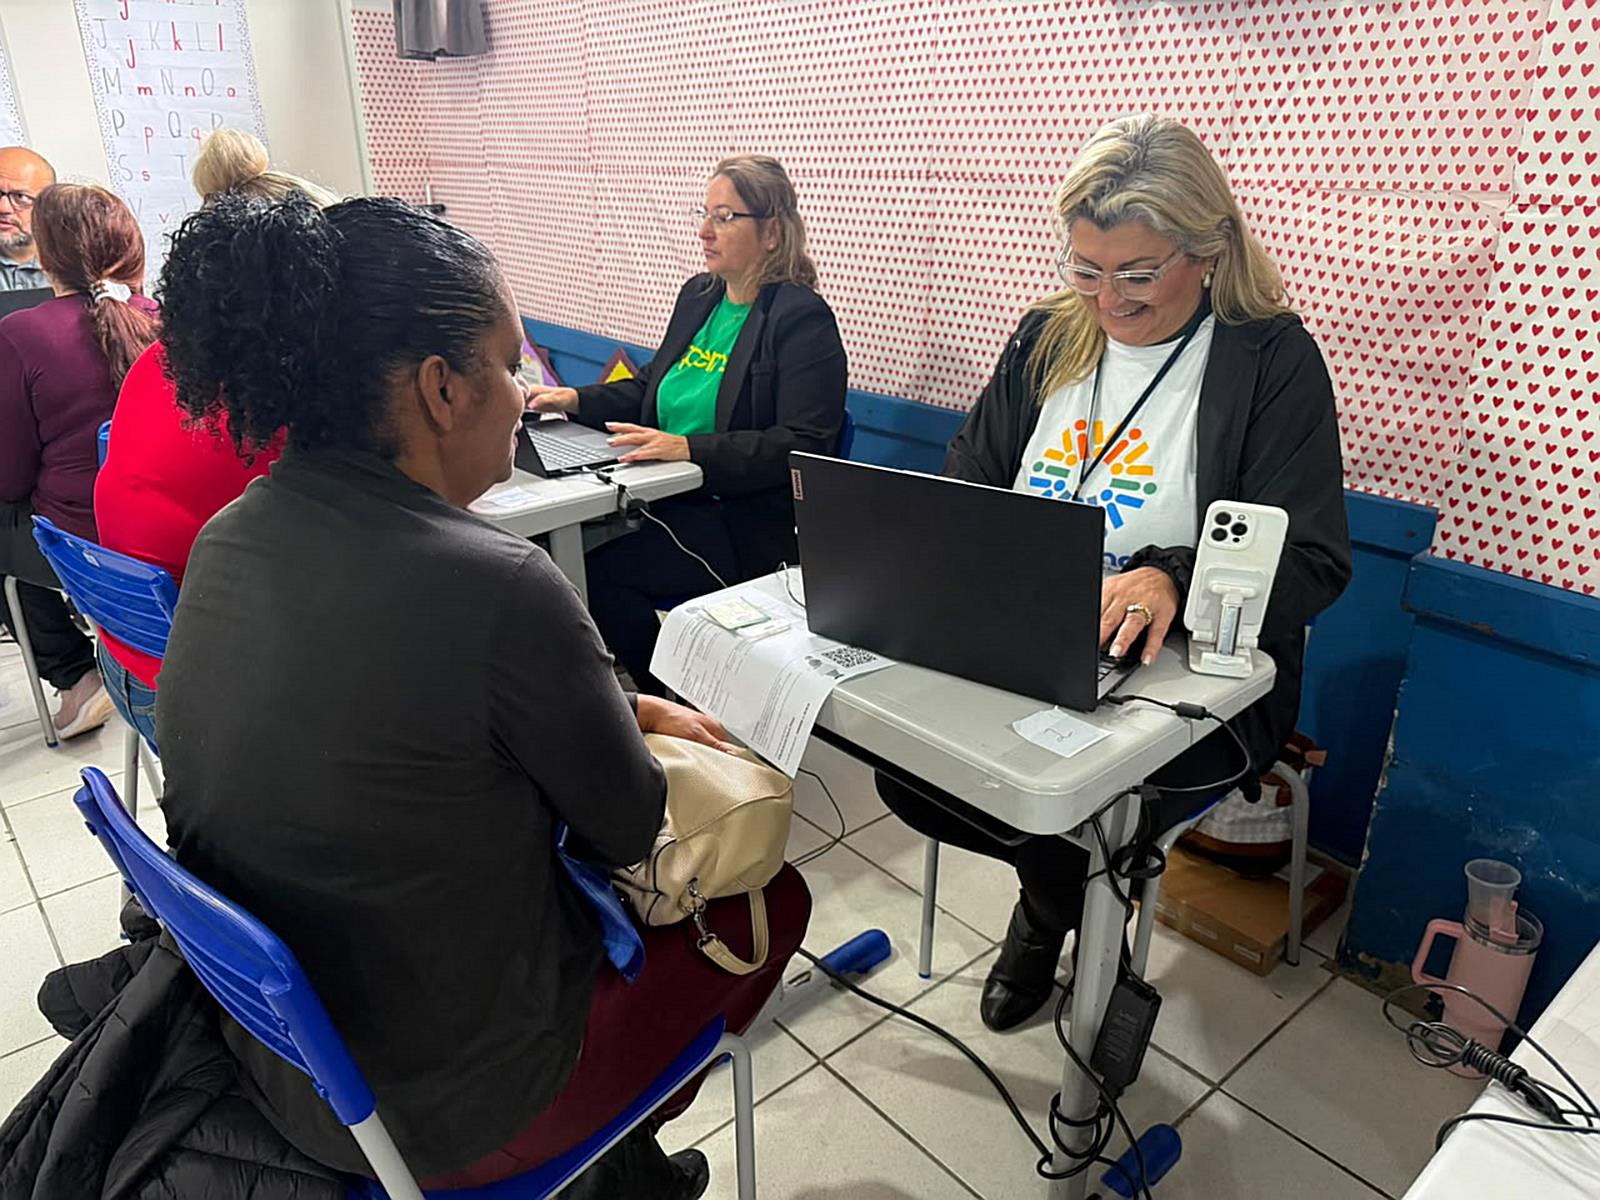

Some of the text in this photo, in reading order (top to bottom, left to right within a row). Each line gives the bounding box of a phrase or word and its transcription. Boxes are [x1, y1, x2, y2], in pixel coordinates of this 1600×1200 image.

[149, 21, 161, 50] K
[170, 21, 182, 51] k
[195, 22, 211, 52] L
[102, 67, 122, 95] M
[138, 86, 153, 96] m
[160, 68, 175, 95] N
[185, 86, 196, 97] n
[112, 109, 125, 137] P
[144, 126, 154, 155] p
[168, 111, 181, 138] Q
[118, 153, 187, 182] S s T
